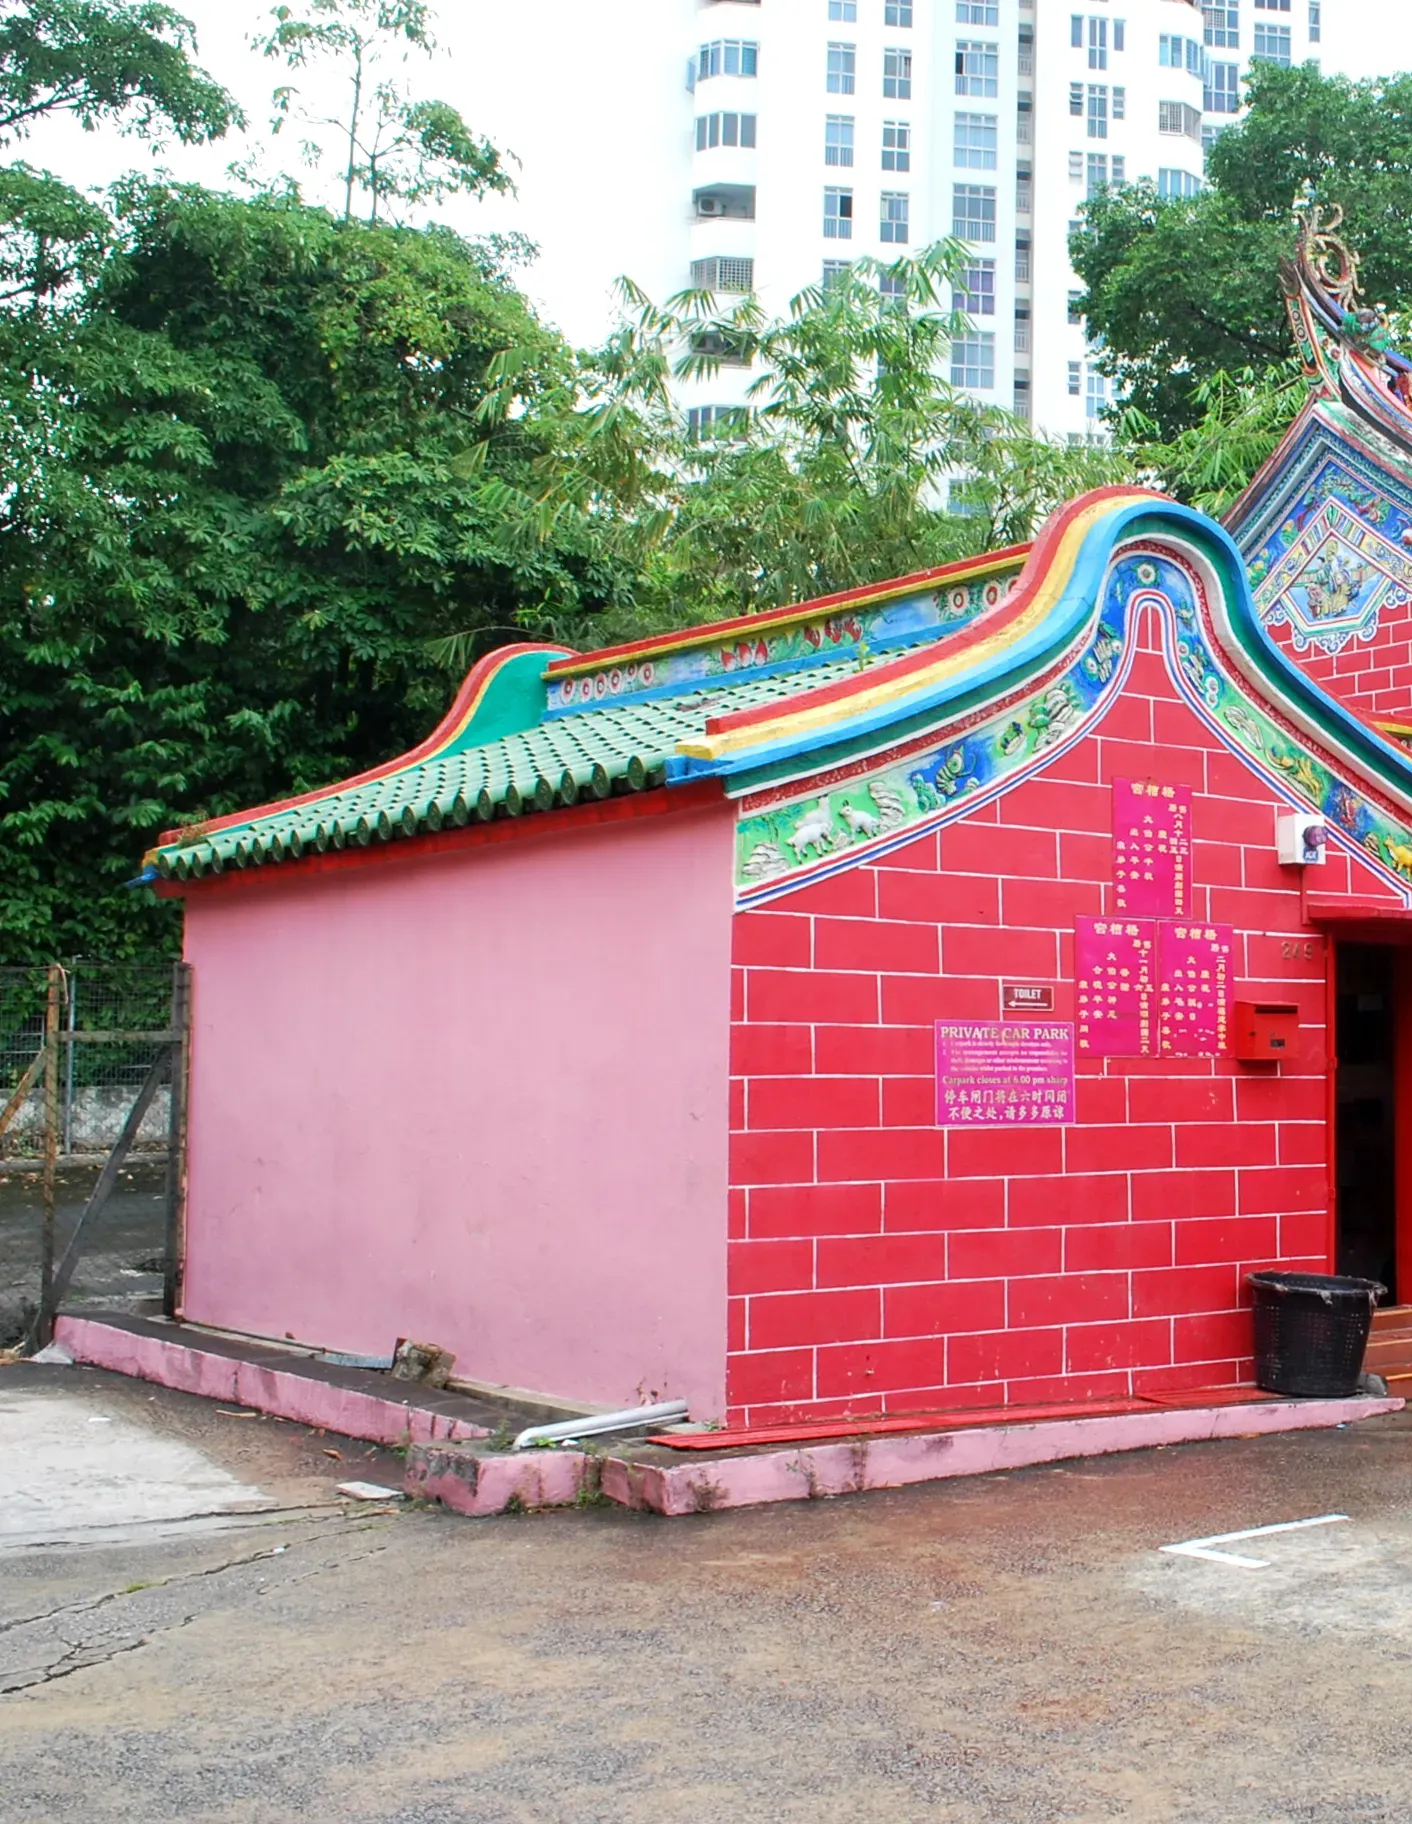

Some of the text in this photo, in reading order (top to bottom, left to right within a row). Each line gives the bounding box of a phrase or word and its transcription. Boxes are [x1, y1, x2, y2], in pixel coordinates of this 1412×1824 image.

[1280, 940, 1314, 960] 249
[1013, 988, 1042, 999] TOILET
[940, 1026, 1069, 1040] PRIVATE CAR PARK
[942, 1075, 975, 1086] Carpark
[976, 1075, 1002, 1085] closes
[1003, 1076, 1011, 1085] at
[1032, 1077, 1045, 1086] pm
[1046, 1075, 1068, 1086] sharp
